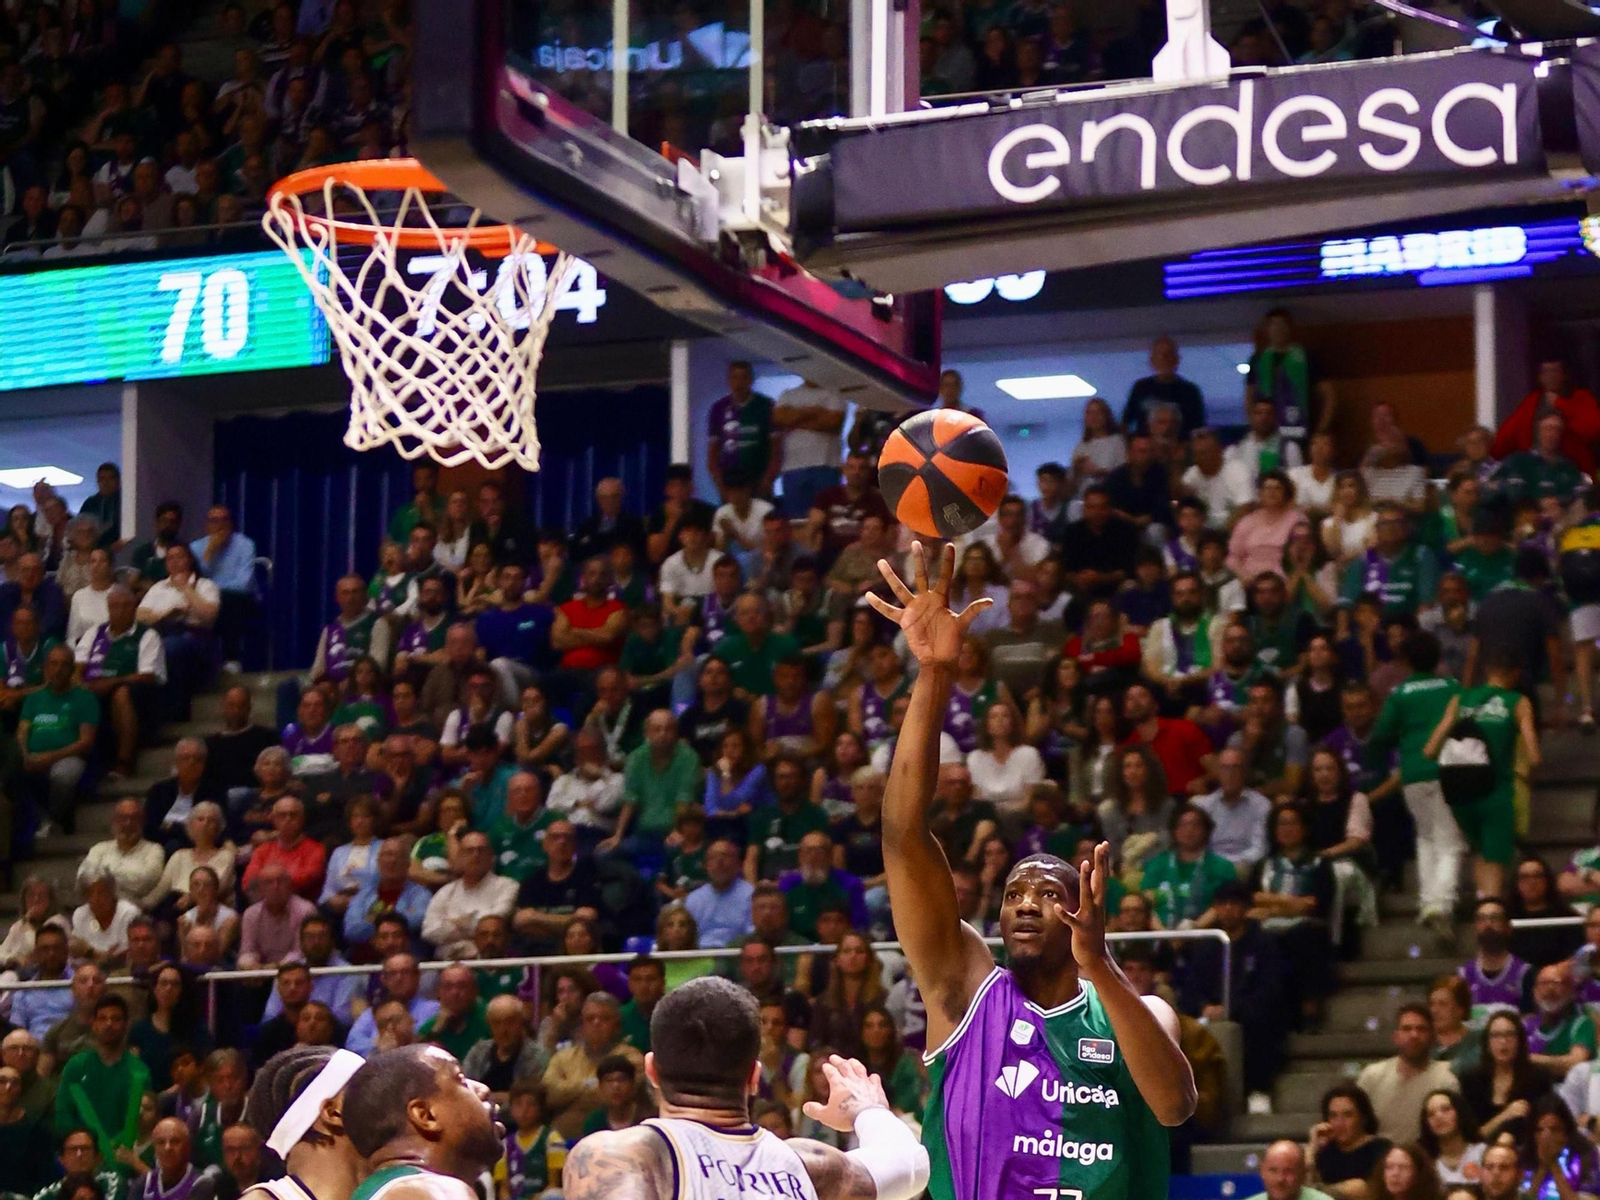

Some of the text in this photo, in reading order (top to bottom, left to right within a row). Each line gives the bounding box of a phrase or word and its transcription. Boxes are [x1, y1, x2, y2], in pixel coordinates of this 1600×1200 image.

[988, 79, 1517, 203] endesa
[157, 268, 250, 363] 70
[407, 252, 606, 338] 7:04
[1041, 1078, 1120, 1109] Unicaja
[1012, 1129, 1114, 1166] málaga
